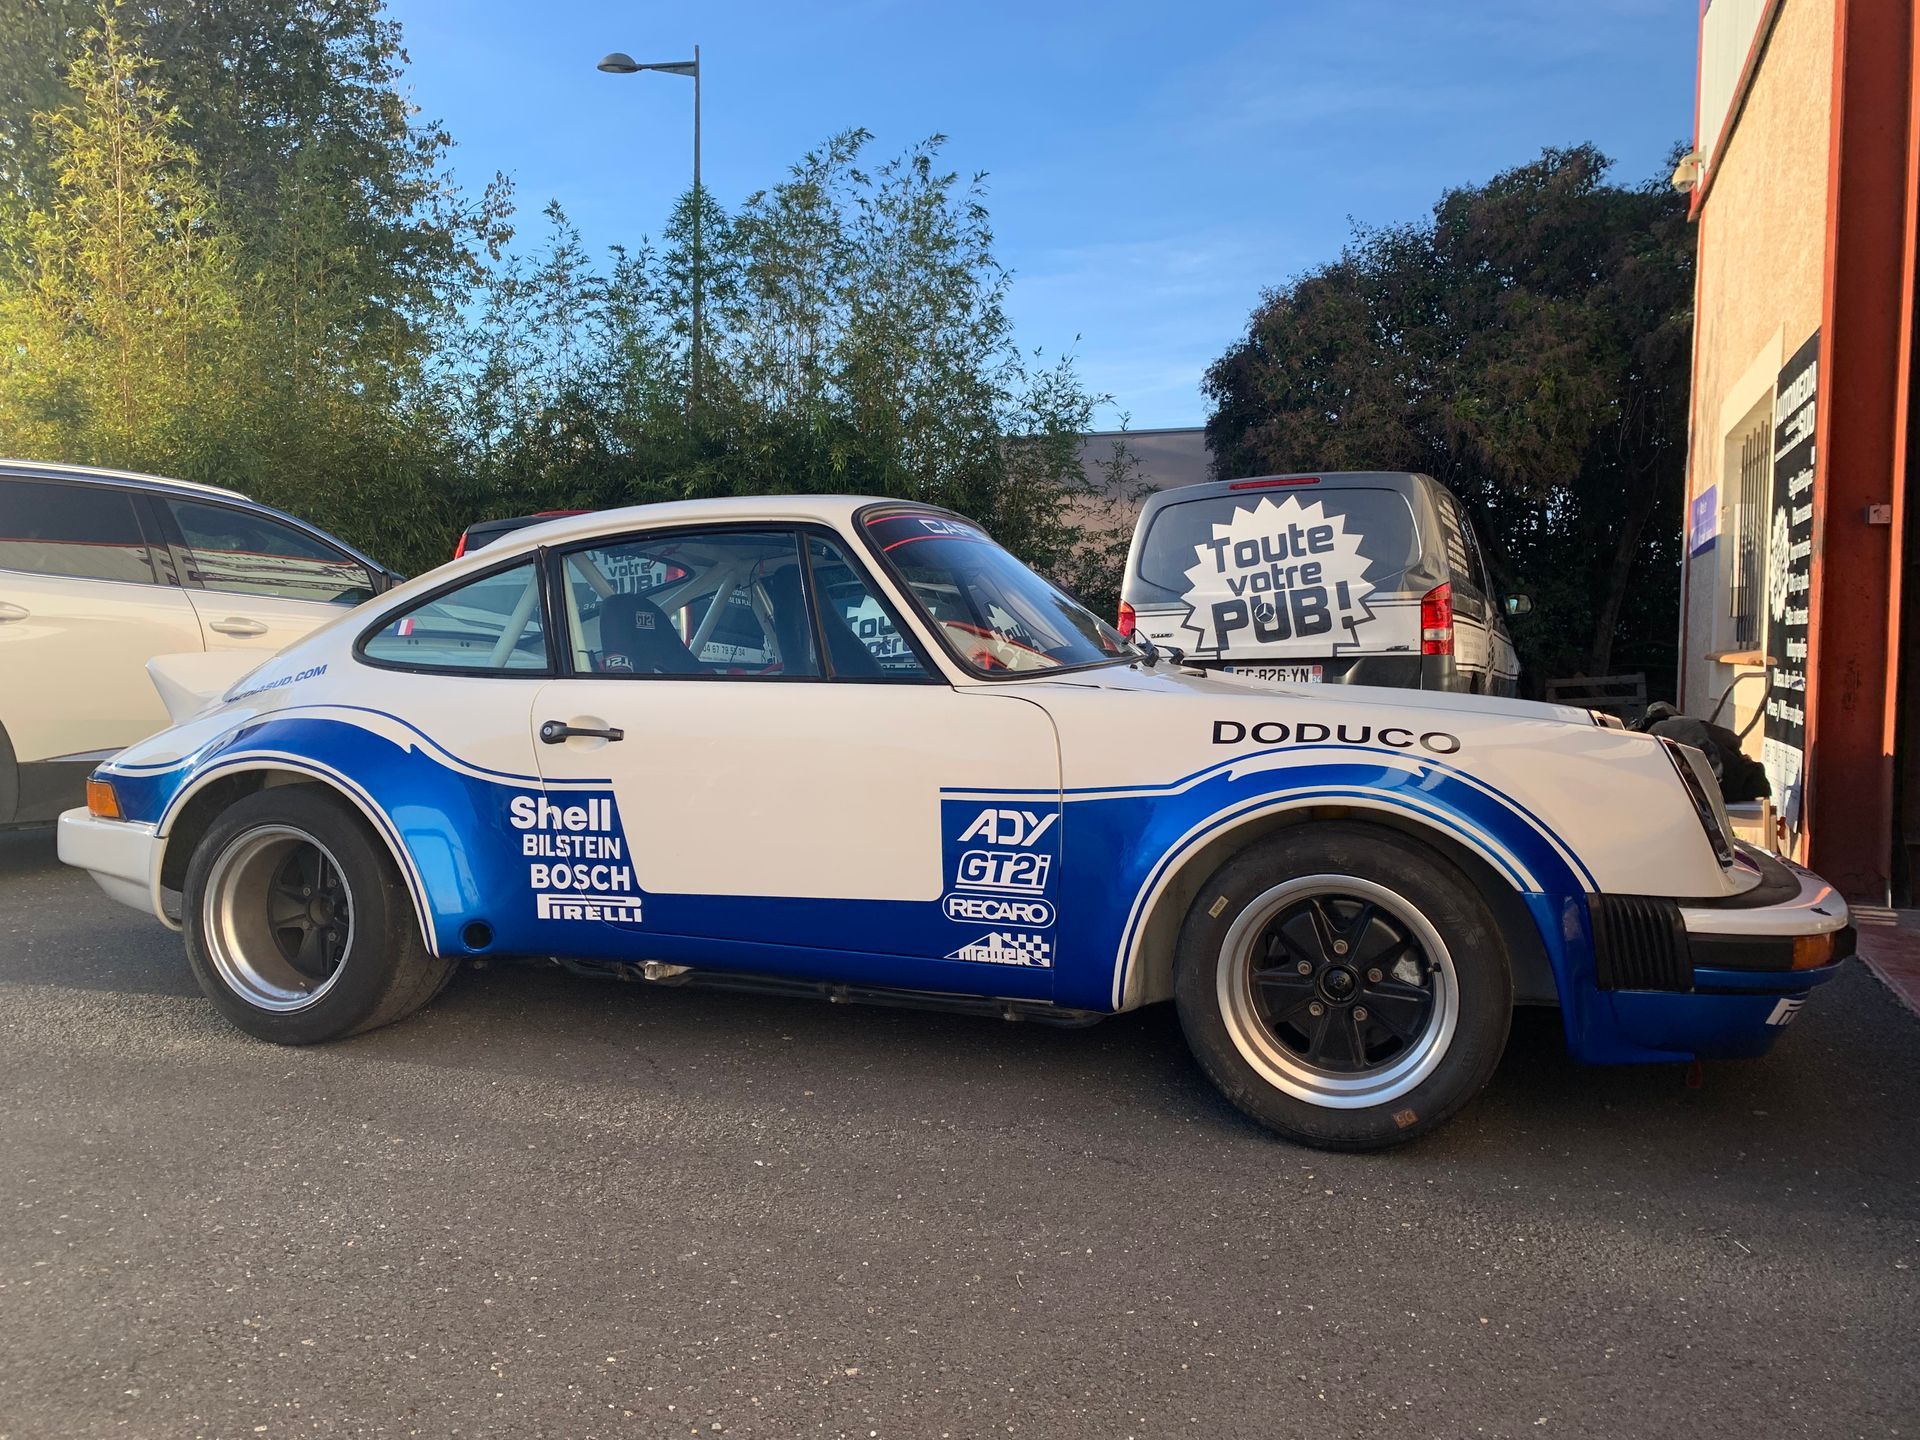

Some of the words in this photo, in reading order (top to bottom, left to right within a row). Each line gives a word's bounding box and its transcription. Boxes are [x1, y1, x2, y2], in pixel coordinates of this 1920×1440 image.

[1207, 523, 1335, 574] Toute
[608, 560, 651, 578] votre
[1226, 561, 1322, 597] votre
[1212, 720, 1461, 754] DODUCO
[510, 795, 611, 831] Shell
[523, 833, 621, 859] BILSTEIN
[531, 863, 631, 891] BOSCH
[537, 893, 642, 922] PIRELLI
[949, 898, 1048, 923] RECARO
